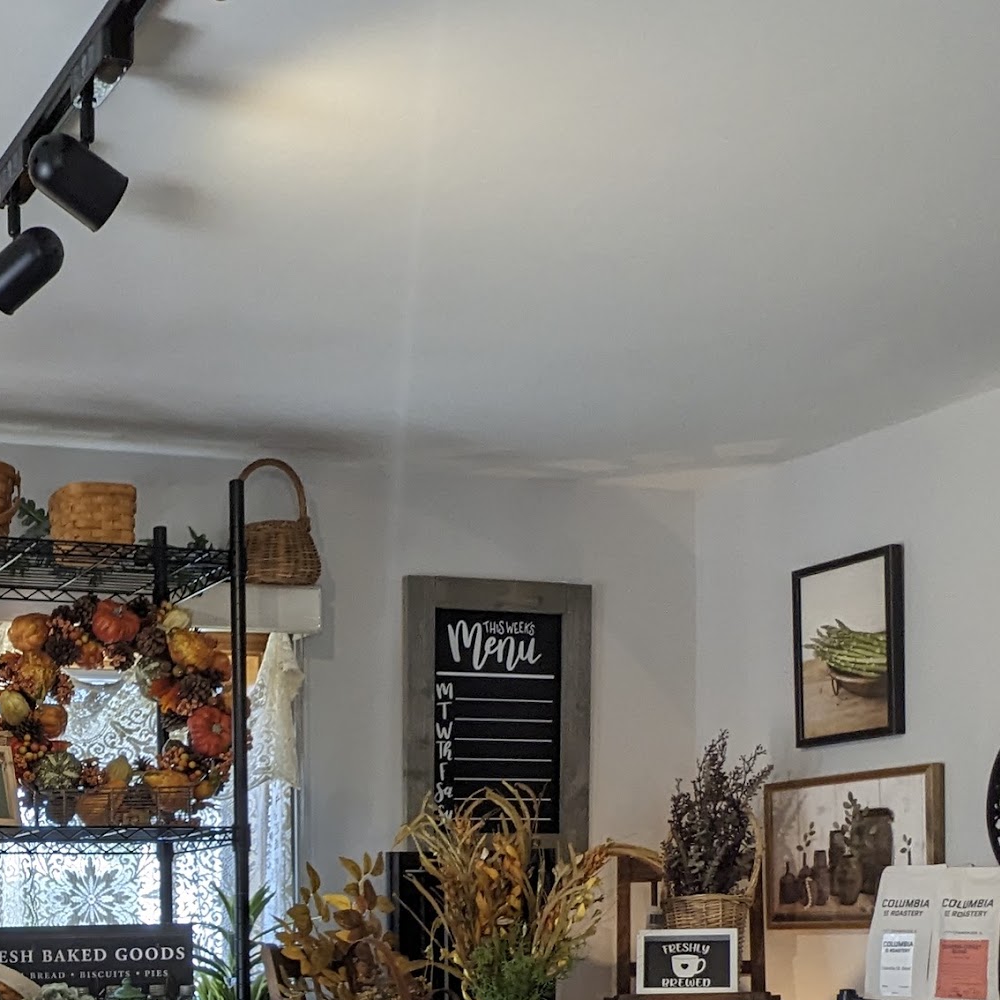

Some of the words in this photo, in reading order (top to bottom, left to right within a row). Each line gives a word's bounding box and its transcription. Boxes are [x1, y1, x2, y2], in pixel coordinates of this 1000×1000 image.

[482, 620, 505, 636] THIS
[447, 620, 542, 672] Menu
[435, 682, 454, 700] M
[436, 702, 453, 720] T
[435, 722, 453, 740] W
[435, 741, 453, 761] Th
[438, 762, 449, 782] F
[434, 781, 454, 804] Sa
[882, 898, 930, 909] COLUMBIA
[942, 898, 994, 909] COLUMBIA
[42, 948, 107, 963] BAKED
[115, 946, 187, 962] GOODS
[661, 942, 711, 956] FRESHLY
[30, 971, 66, 980] BREAD
[79, 970, 131, 979] BISCUITS
[144, 969, 169, 978] PIES
[661, 977, 712, 988] BREWED
